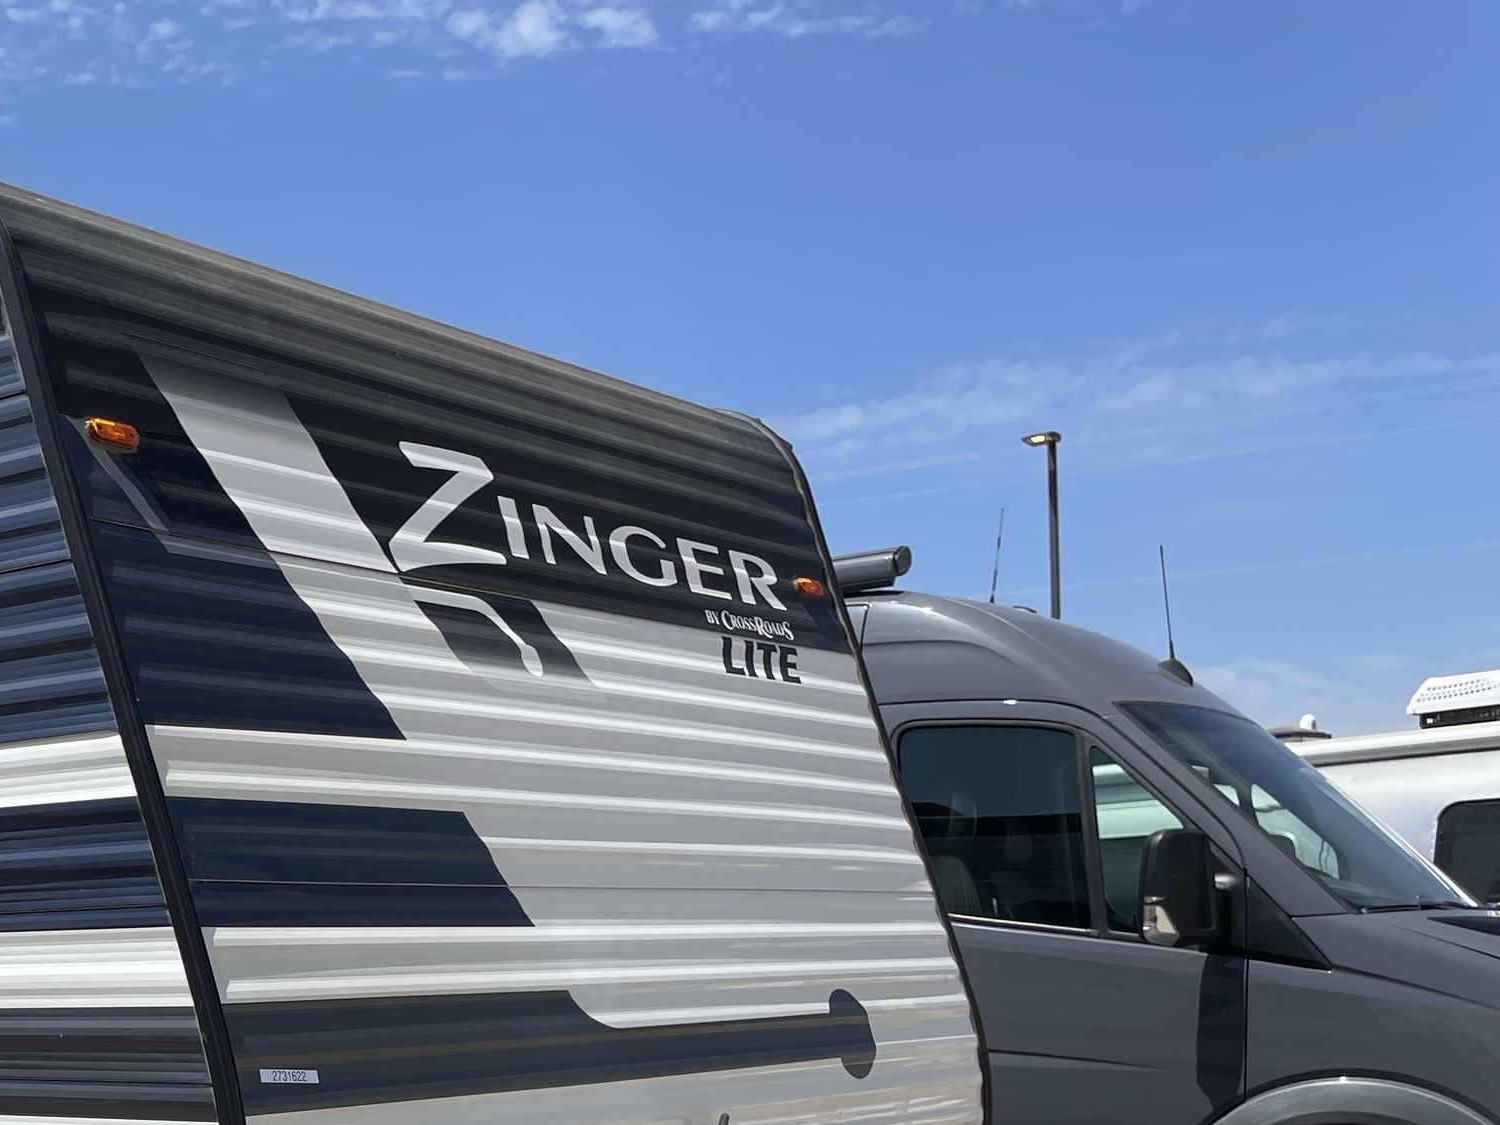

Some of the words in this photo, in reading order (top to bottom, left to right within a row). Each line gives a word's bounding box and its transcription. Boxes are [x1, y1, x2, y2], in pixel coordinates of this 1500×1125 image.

[389, 440, 788, 611] ZINGER
[704, 608, 720, 625] BY
[722, 635, 802, 684] LITE
[272, 1070, 308, 1082] 2731622
